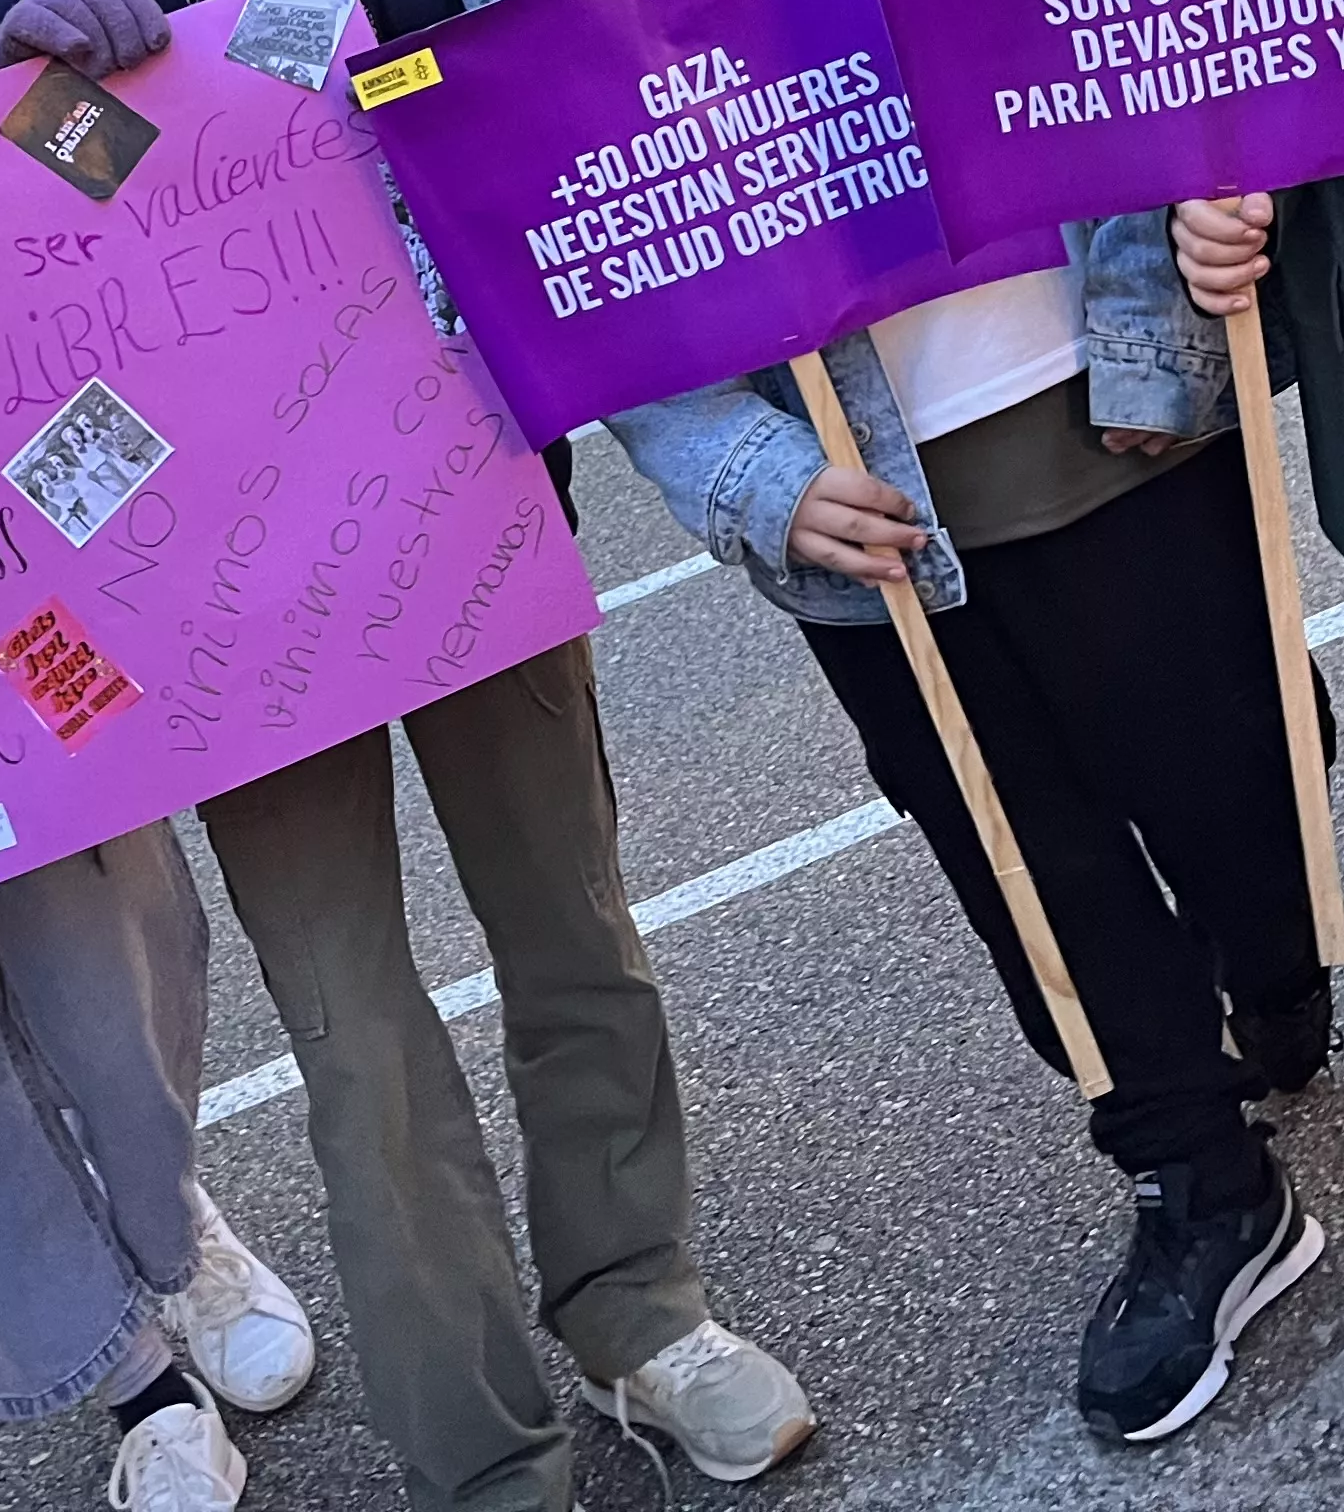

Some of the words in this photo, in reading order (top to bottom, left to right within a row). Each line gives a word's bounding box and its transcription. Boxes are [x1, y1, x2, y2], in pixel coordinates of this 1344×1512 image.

[637, 46, 750, 120] GAZA:
[995, 78, 1110, 134] PARA
[1120, 33, 1318, 118] MUJERES
[43, 140, 57, 153] I
[55, 120, 76, 142] am
[551, 117, 709, 207] +50.000
[706, 51, 880, 151] MUJERES
[525, 161, 737, 271] NECESITAN
[742, 92, 916, 197] SERVICIO
[13, 230, 103, 277] ser
[542, 271, 603, 319] DE
[608, 230, 726, 300] SALUD
[393, 345, 469, 436] con
[358, 406, 504, 665] nuestras
